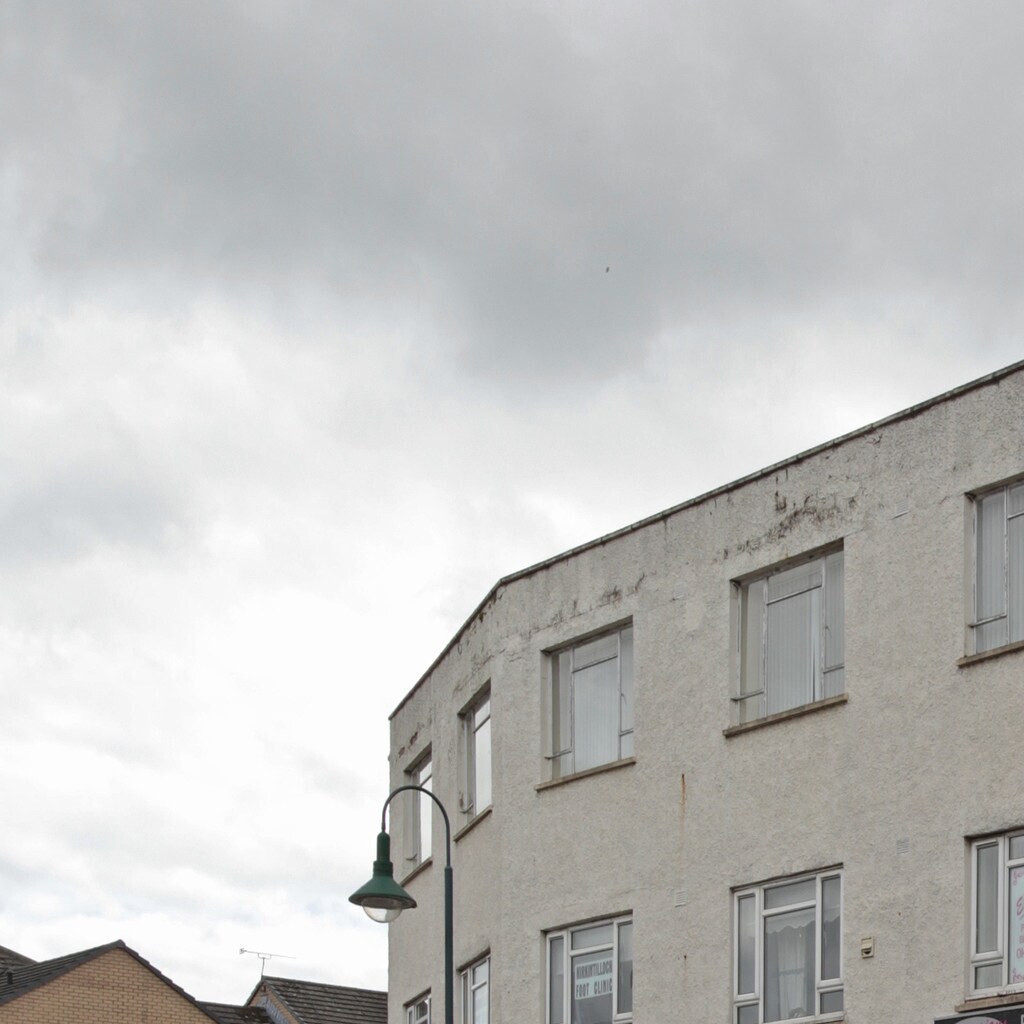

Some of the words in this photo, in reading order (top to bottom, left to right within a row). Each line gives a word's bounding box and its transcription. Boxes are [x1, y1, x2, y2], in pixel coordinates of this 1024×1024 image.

[576, 960, 612, 980] KIRKINTILLOCH
[576, 982, 589, 998] FOOT
[594, 977, 613, 995] CLINIC
